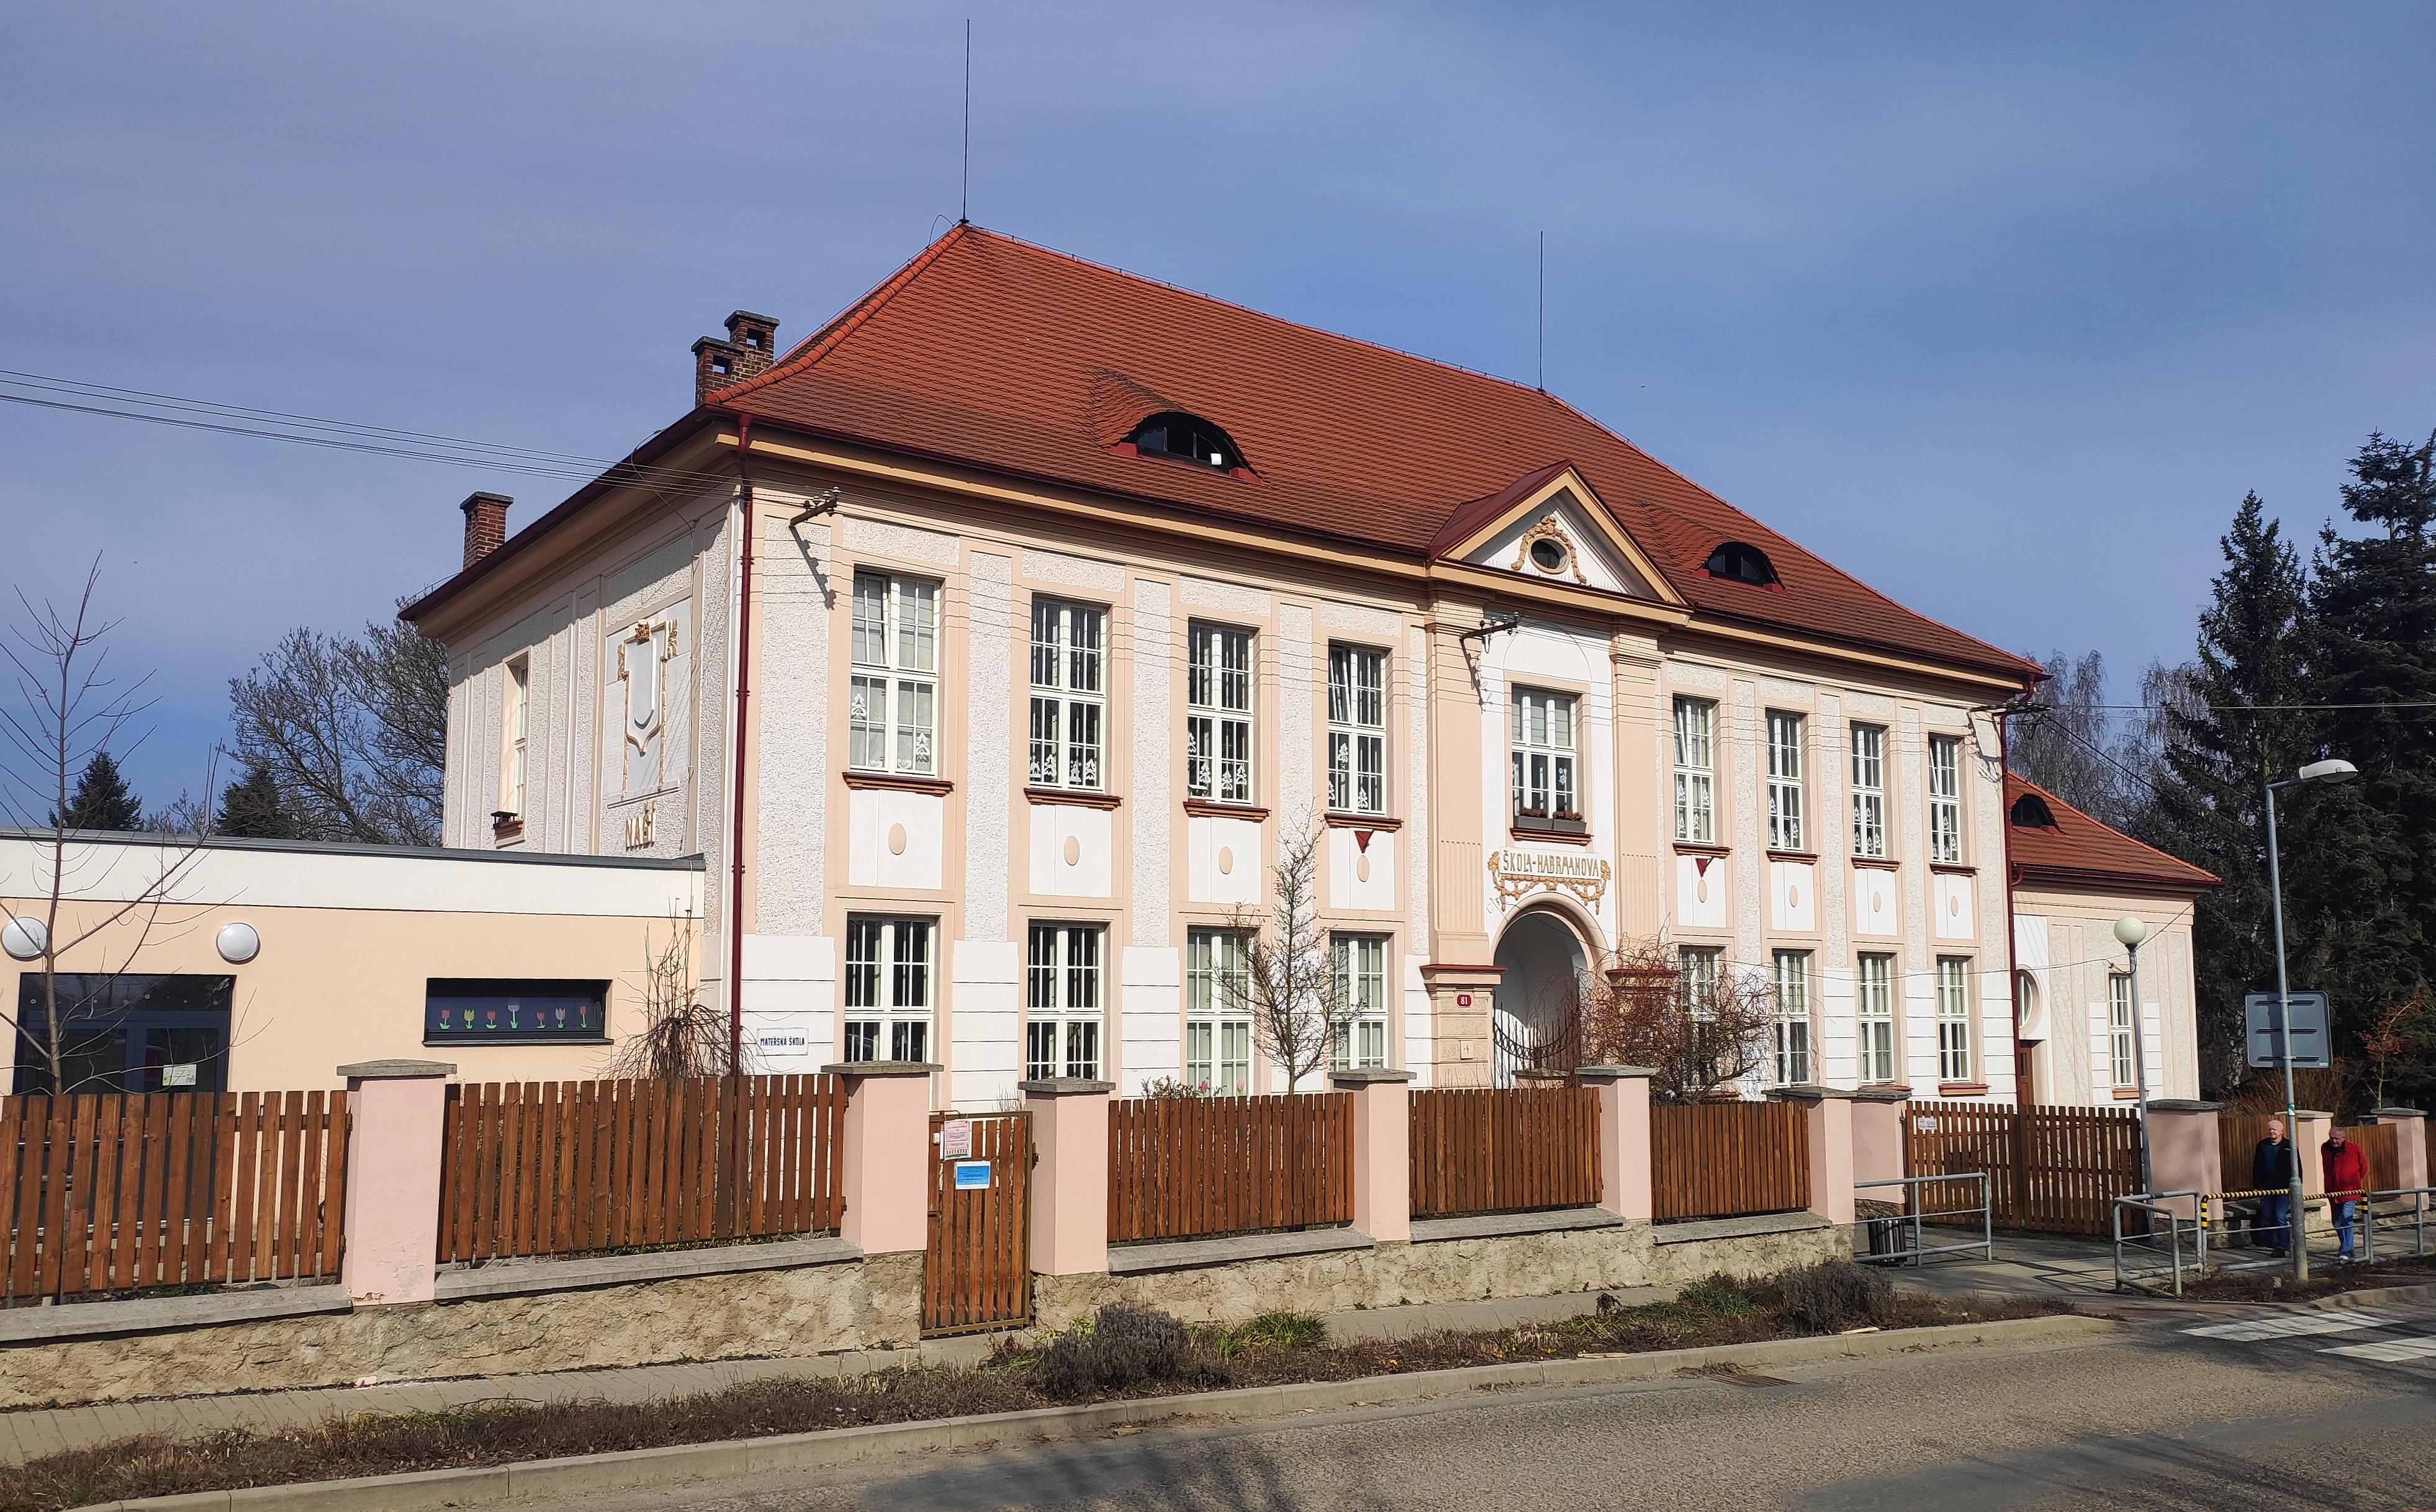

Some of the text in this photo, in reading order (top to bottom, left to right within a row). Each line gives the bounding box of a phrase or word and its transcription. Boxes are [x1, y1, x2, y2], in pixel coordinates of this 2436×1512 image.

[1460, 996, 1468, 1005] 81
[760, 1036, 805, 1046] MATEŘSKÁ ŠKOLA
